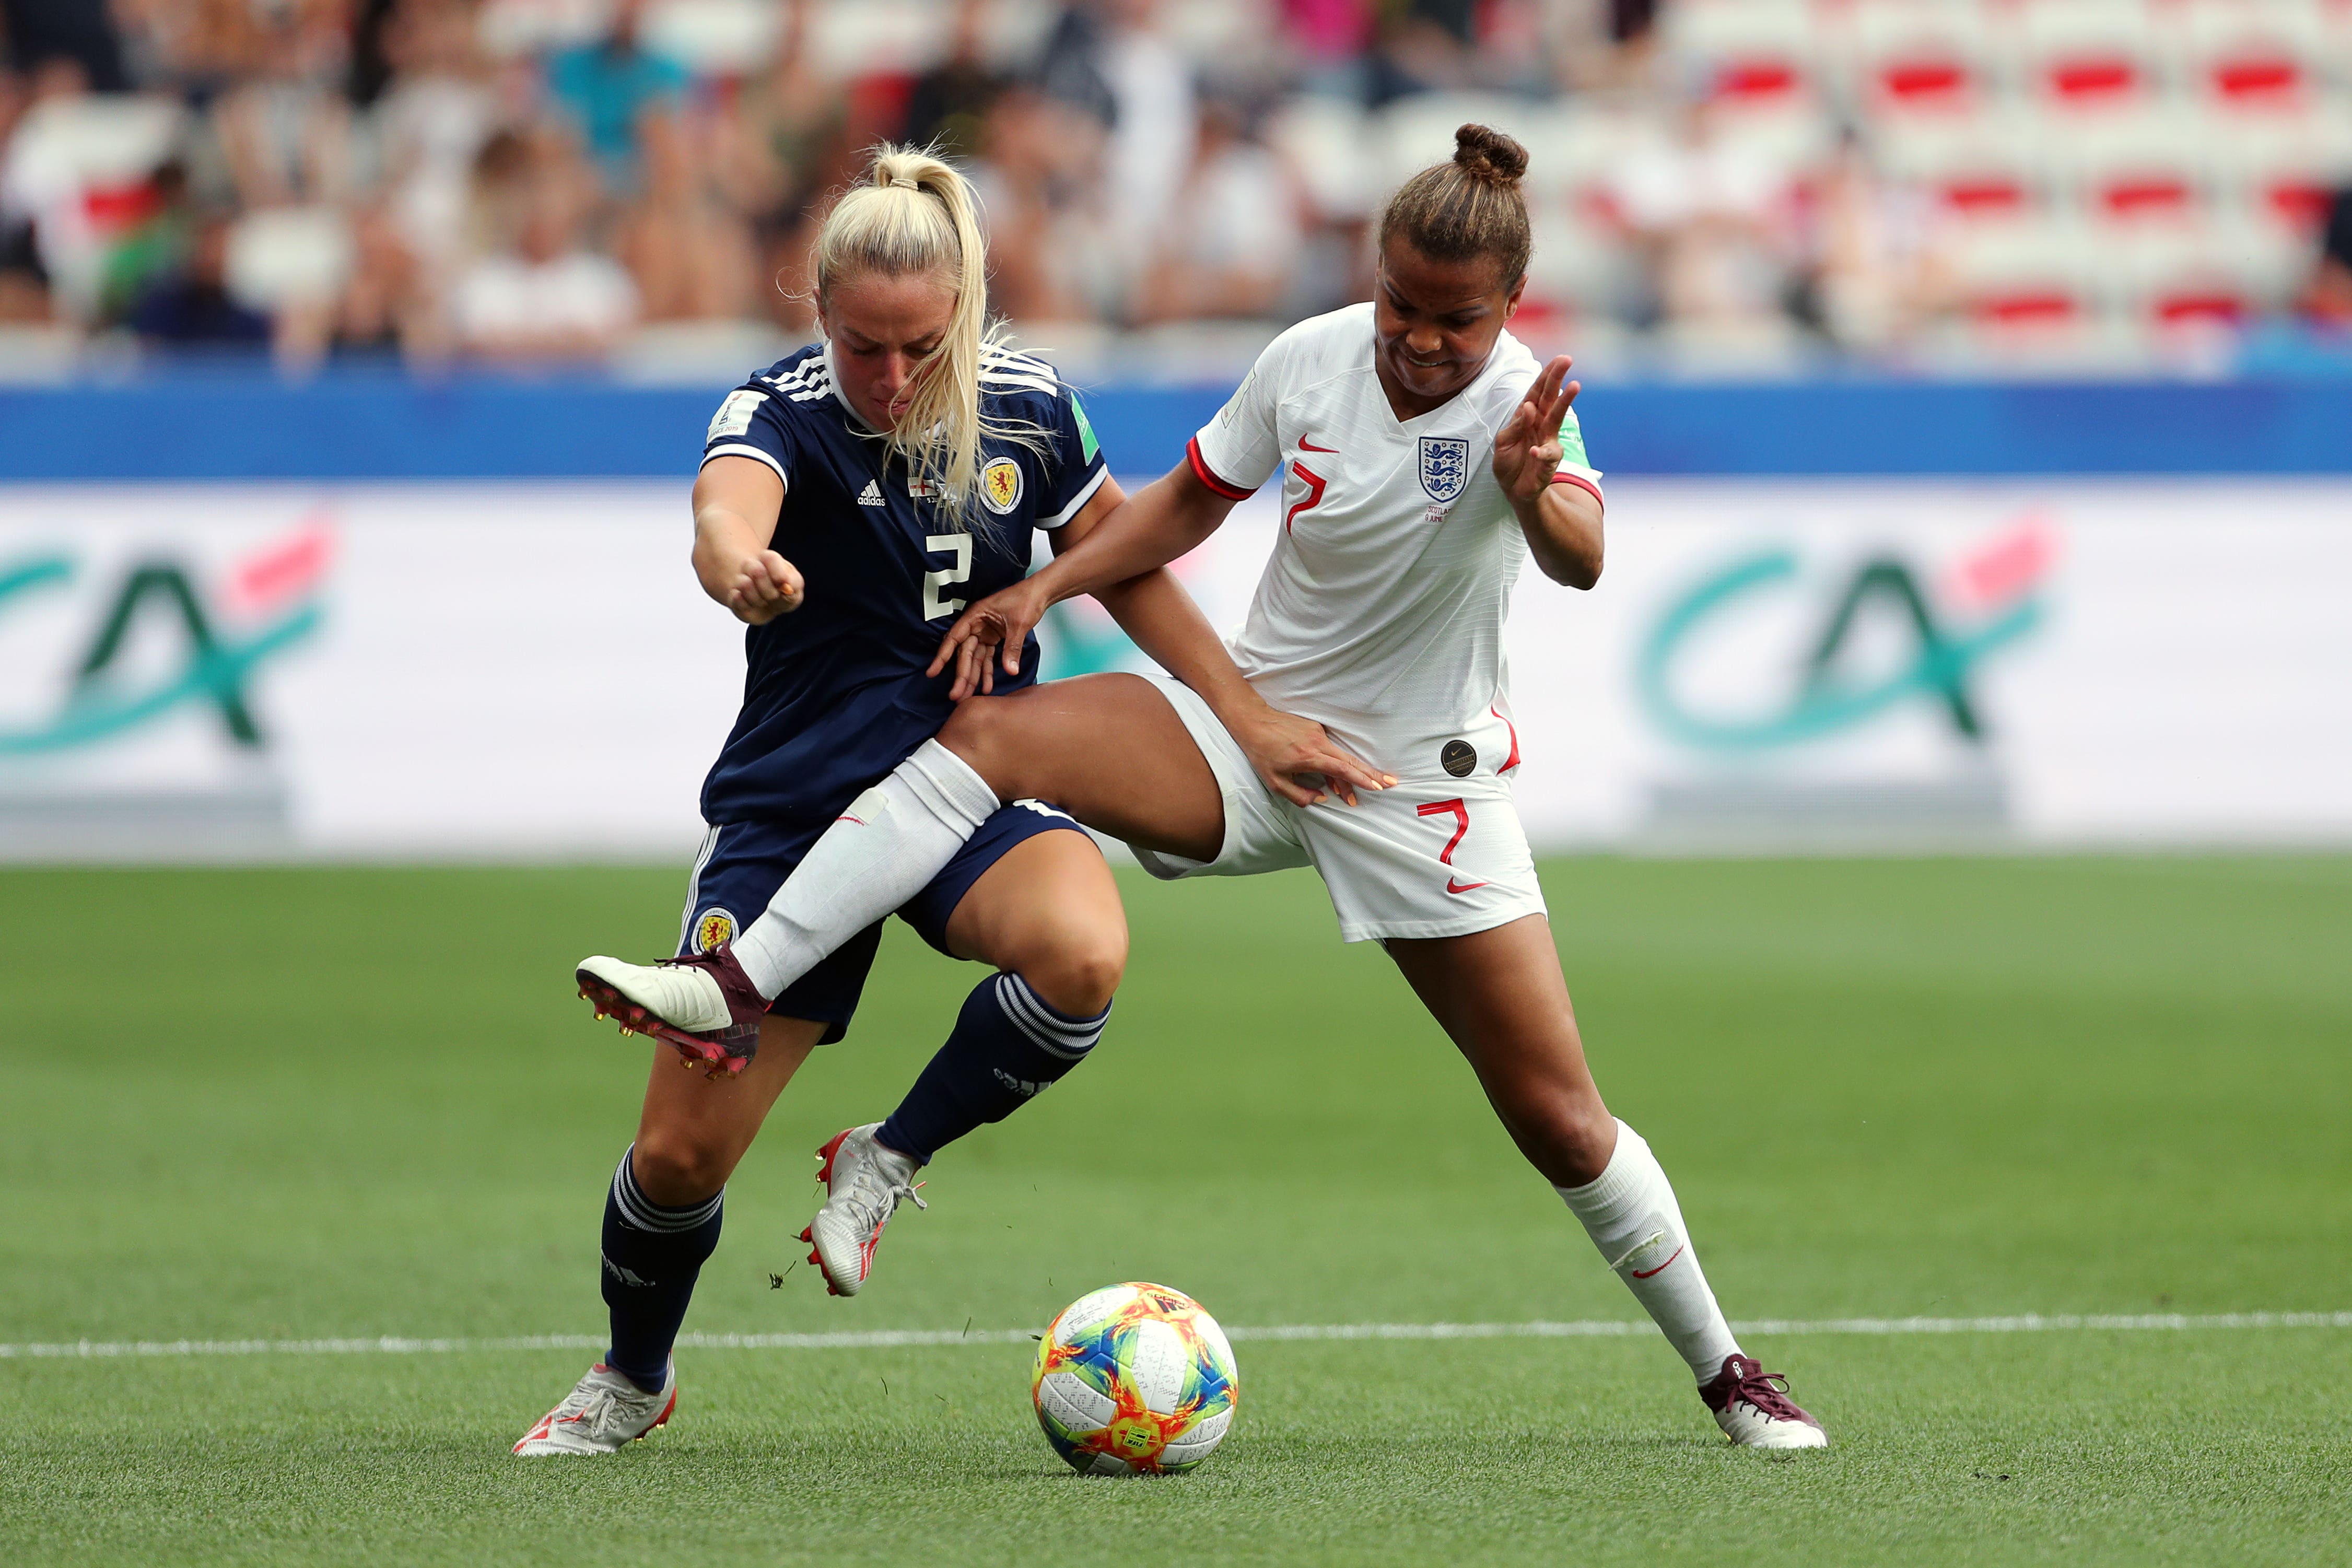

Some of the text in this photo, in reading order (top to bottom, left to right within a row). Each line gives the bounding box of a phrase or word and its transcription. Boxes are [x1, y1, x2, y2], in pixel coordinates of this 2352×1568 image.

[987, 458, 1012, 467] SCOTLAND
[857, 496, 886, 507] adidas
[1286, 461, 1327, 537] 7
[923, 533, 973, 622] 2
[1416, 798, 1469, 866] 7
[708, 910, 730, 919] SCOTLAND
[1147, 1292, 1190, 1308] adidas
[1127, 1438, 1143, 1447] FIFA
